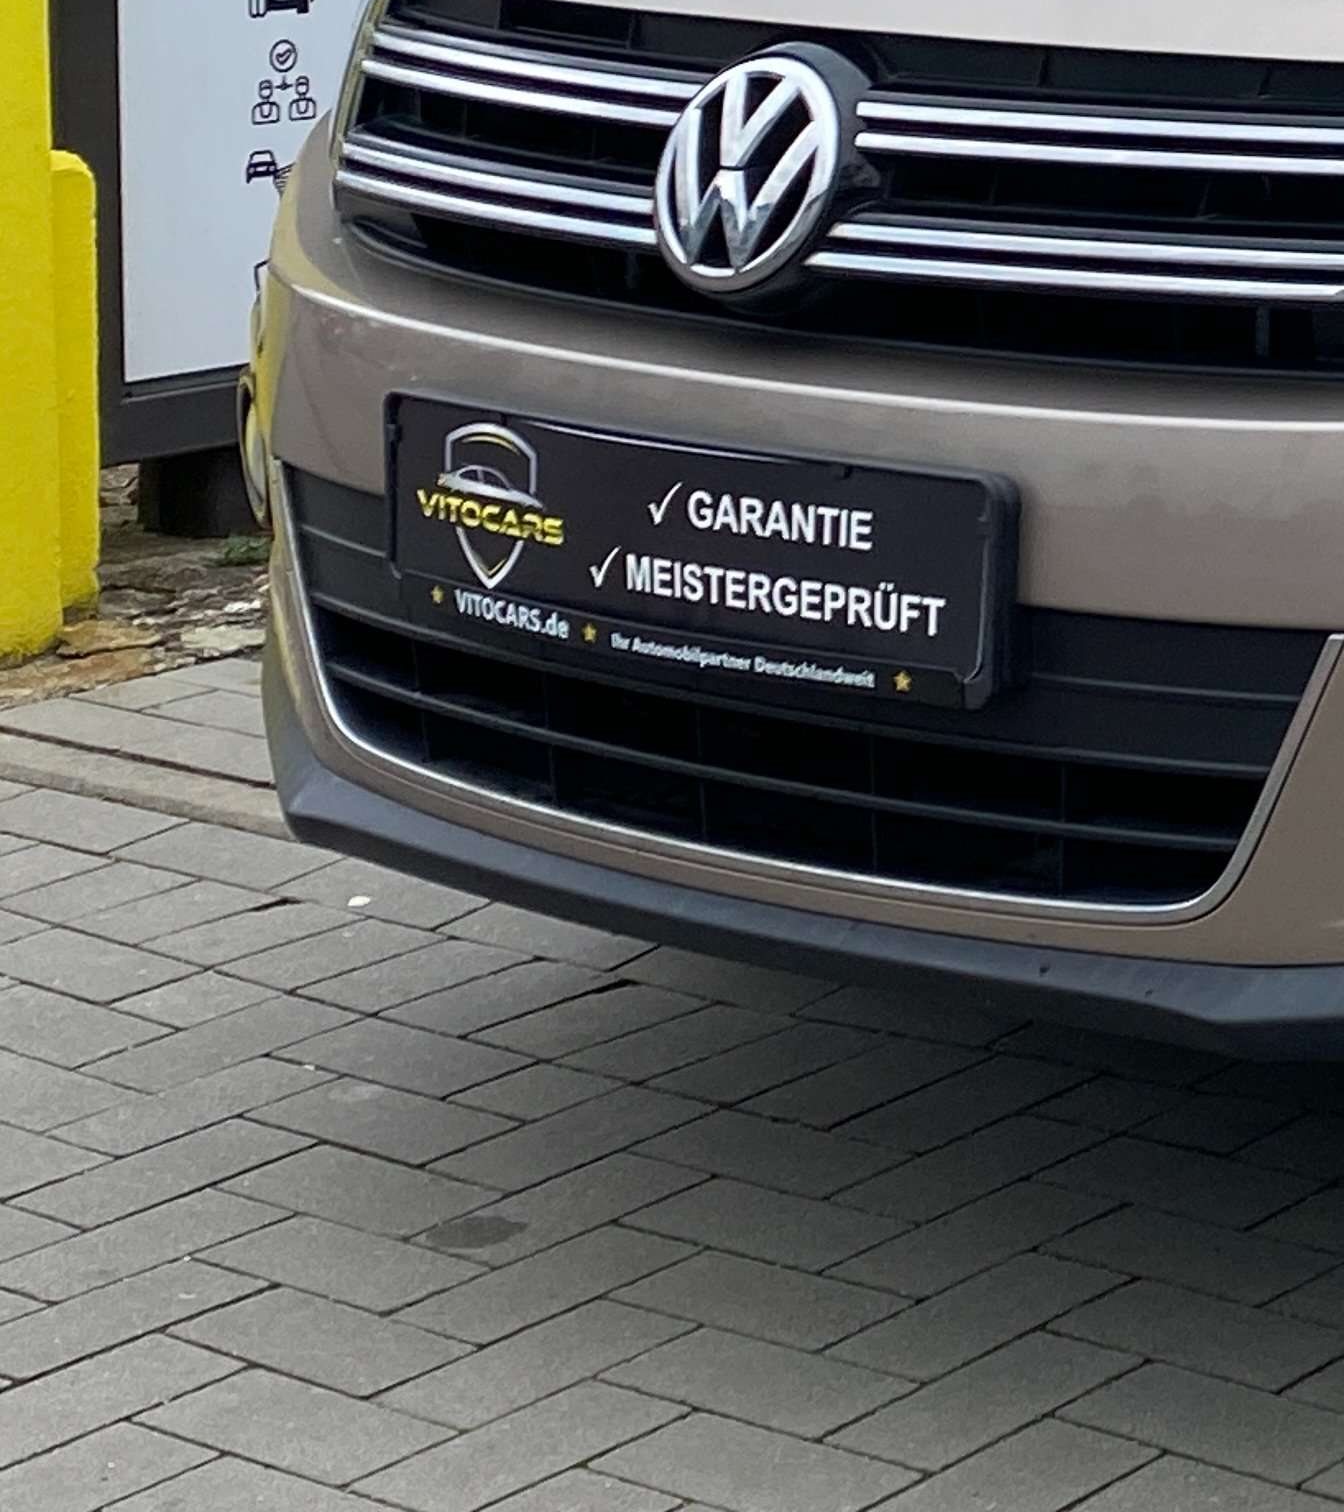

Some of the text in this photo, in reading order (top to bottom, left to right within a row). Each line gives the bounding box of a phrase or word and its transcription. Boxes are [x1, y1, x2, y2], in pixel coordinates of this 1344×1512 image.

[416, 488, 564, 547] VITOCARS
[687, 490, 874, 551] GARANTIE
[454, 588, 570, 640] VITOCARS.de
[624, 552, 946, 637] MEISTERGEPRÜFT
[632, 638, 752, 672] Automobilpartner
